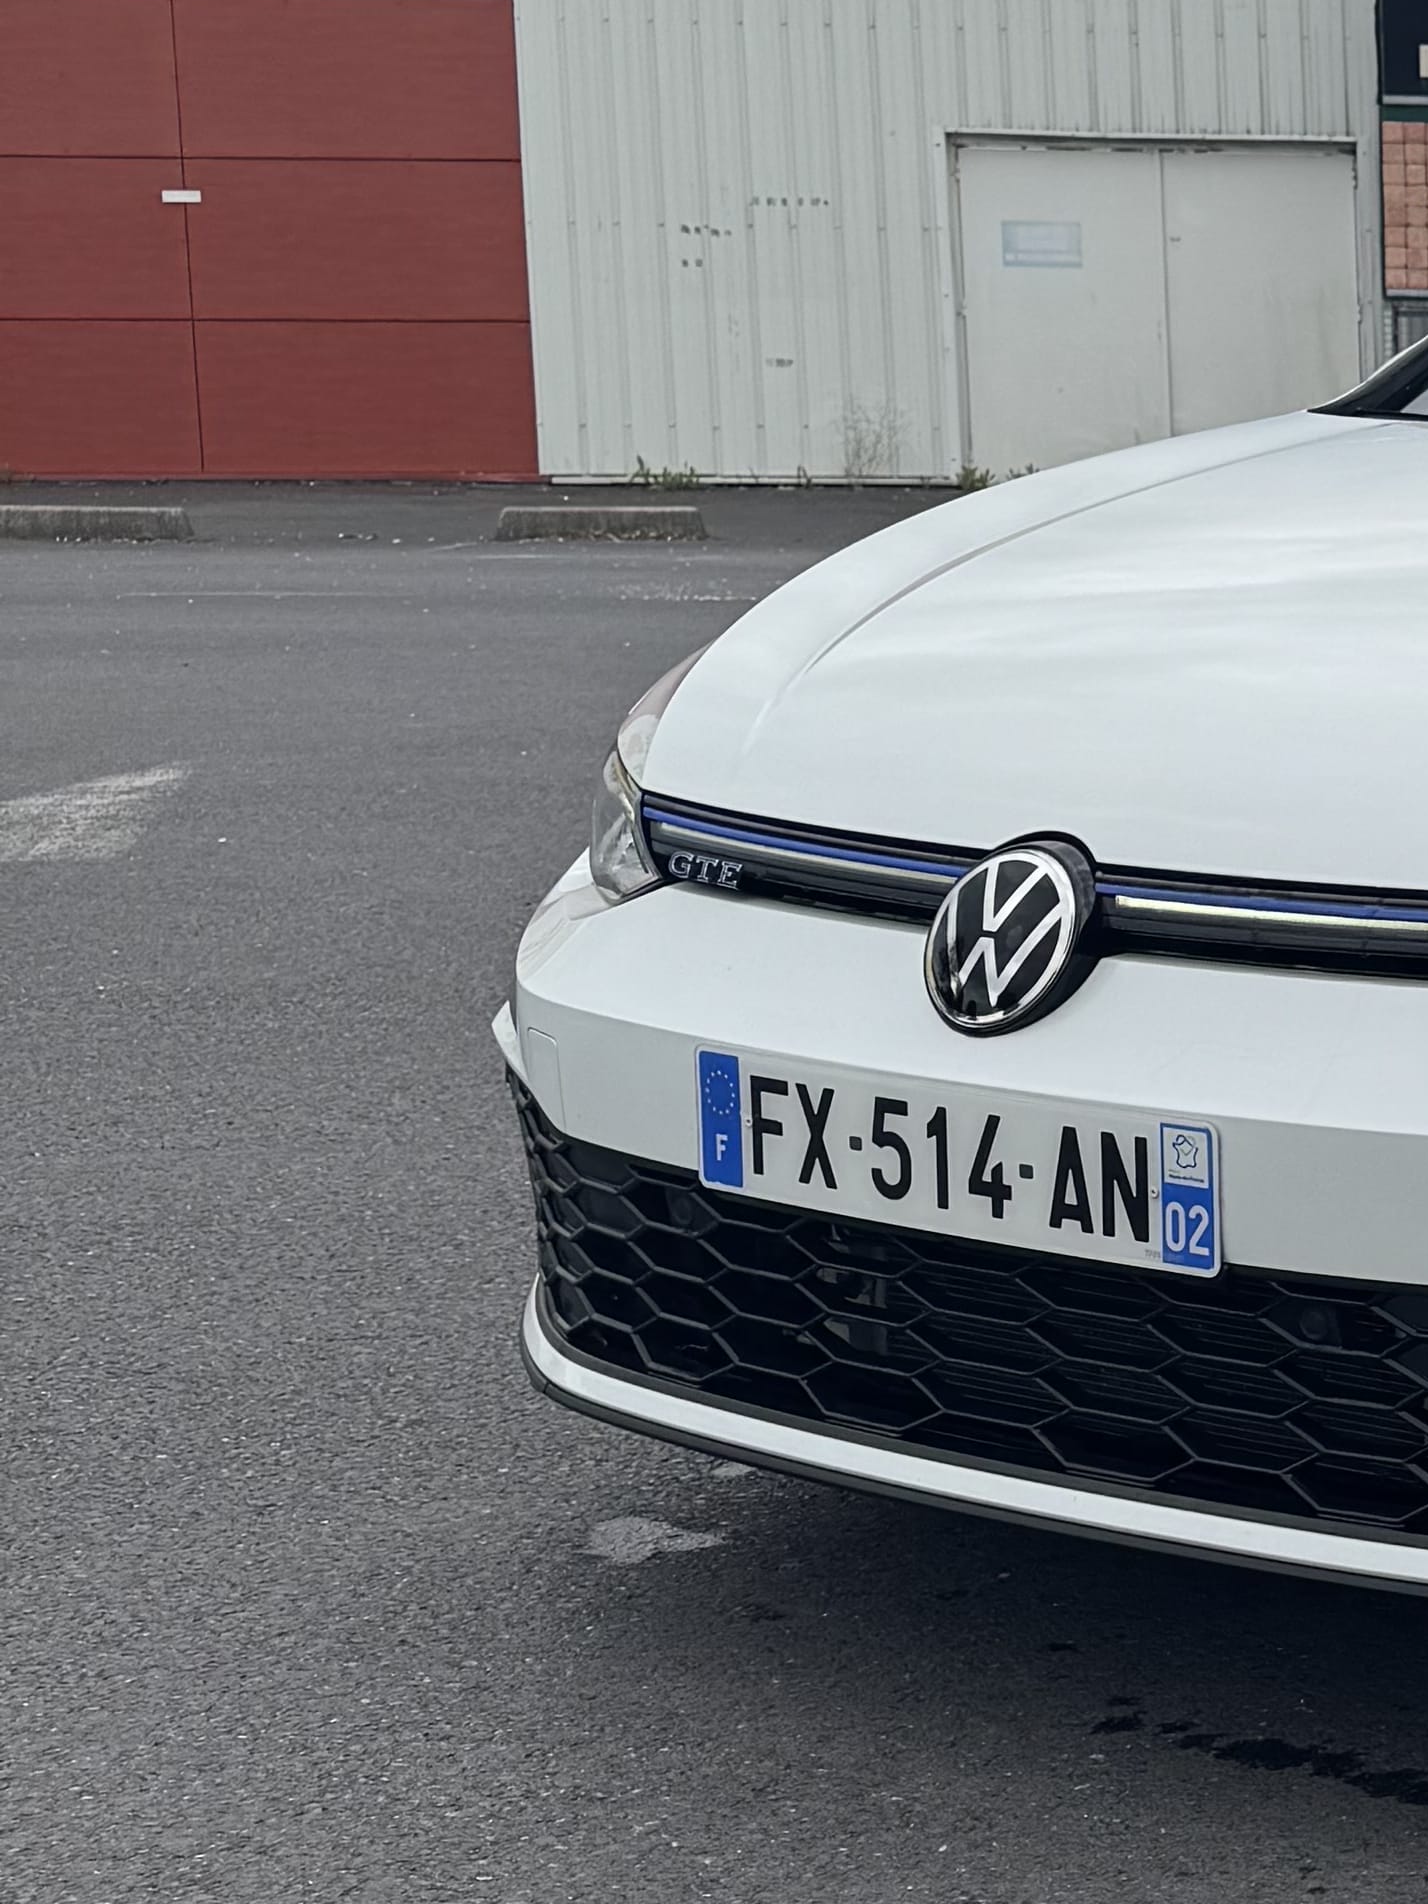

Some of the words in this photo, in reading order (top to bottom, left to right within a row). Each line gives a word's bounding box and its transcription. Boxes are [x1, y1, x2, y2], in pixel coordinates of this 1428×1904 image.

[668, 850, 743, 891] GTE
[930, 852, 1072, 1016] VW
[715, 1133, 728, 1161] F
[1165, 1201, 1210, 1256] 02
